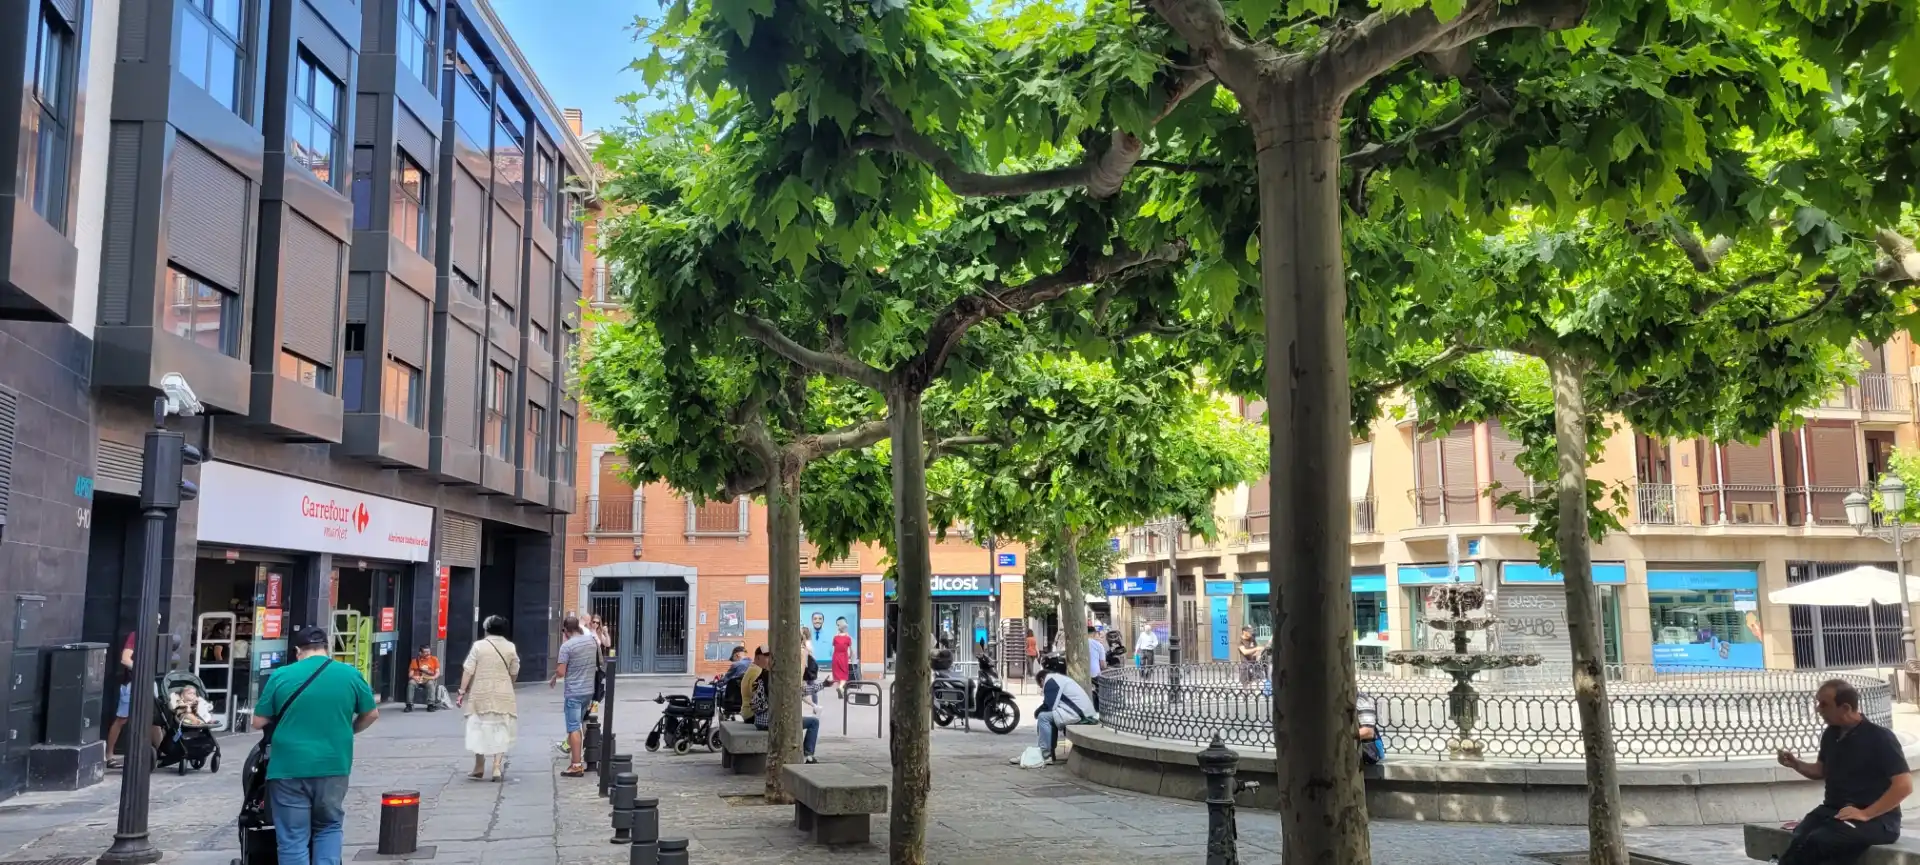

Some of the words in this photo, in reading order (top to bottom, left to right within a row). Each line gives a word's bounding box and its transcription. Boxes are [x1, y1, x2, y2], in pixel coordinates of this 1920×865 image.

[301, 495, 350, 523] Carrefour
[323, 524, 348, 540] market
[930, 576, 979, 591] dicost
